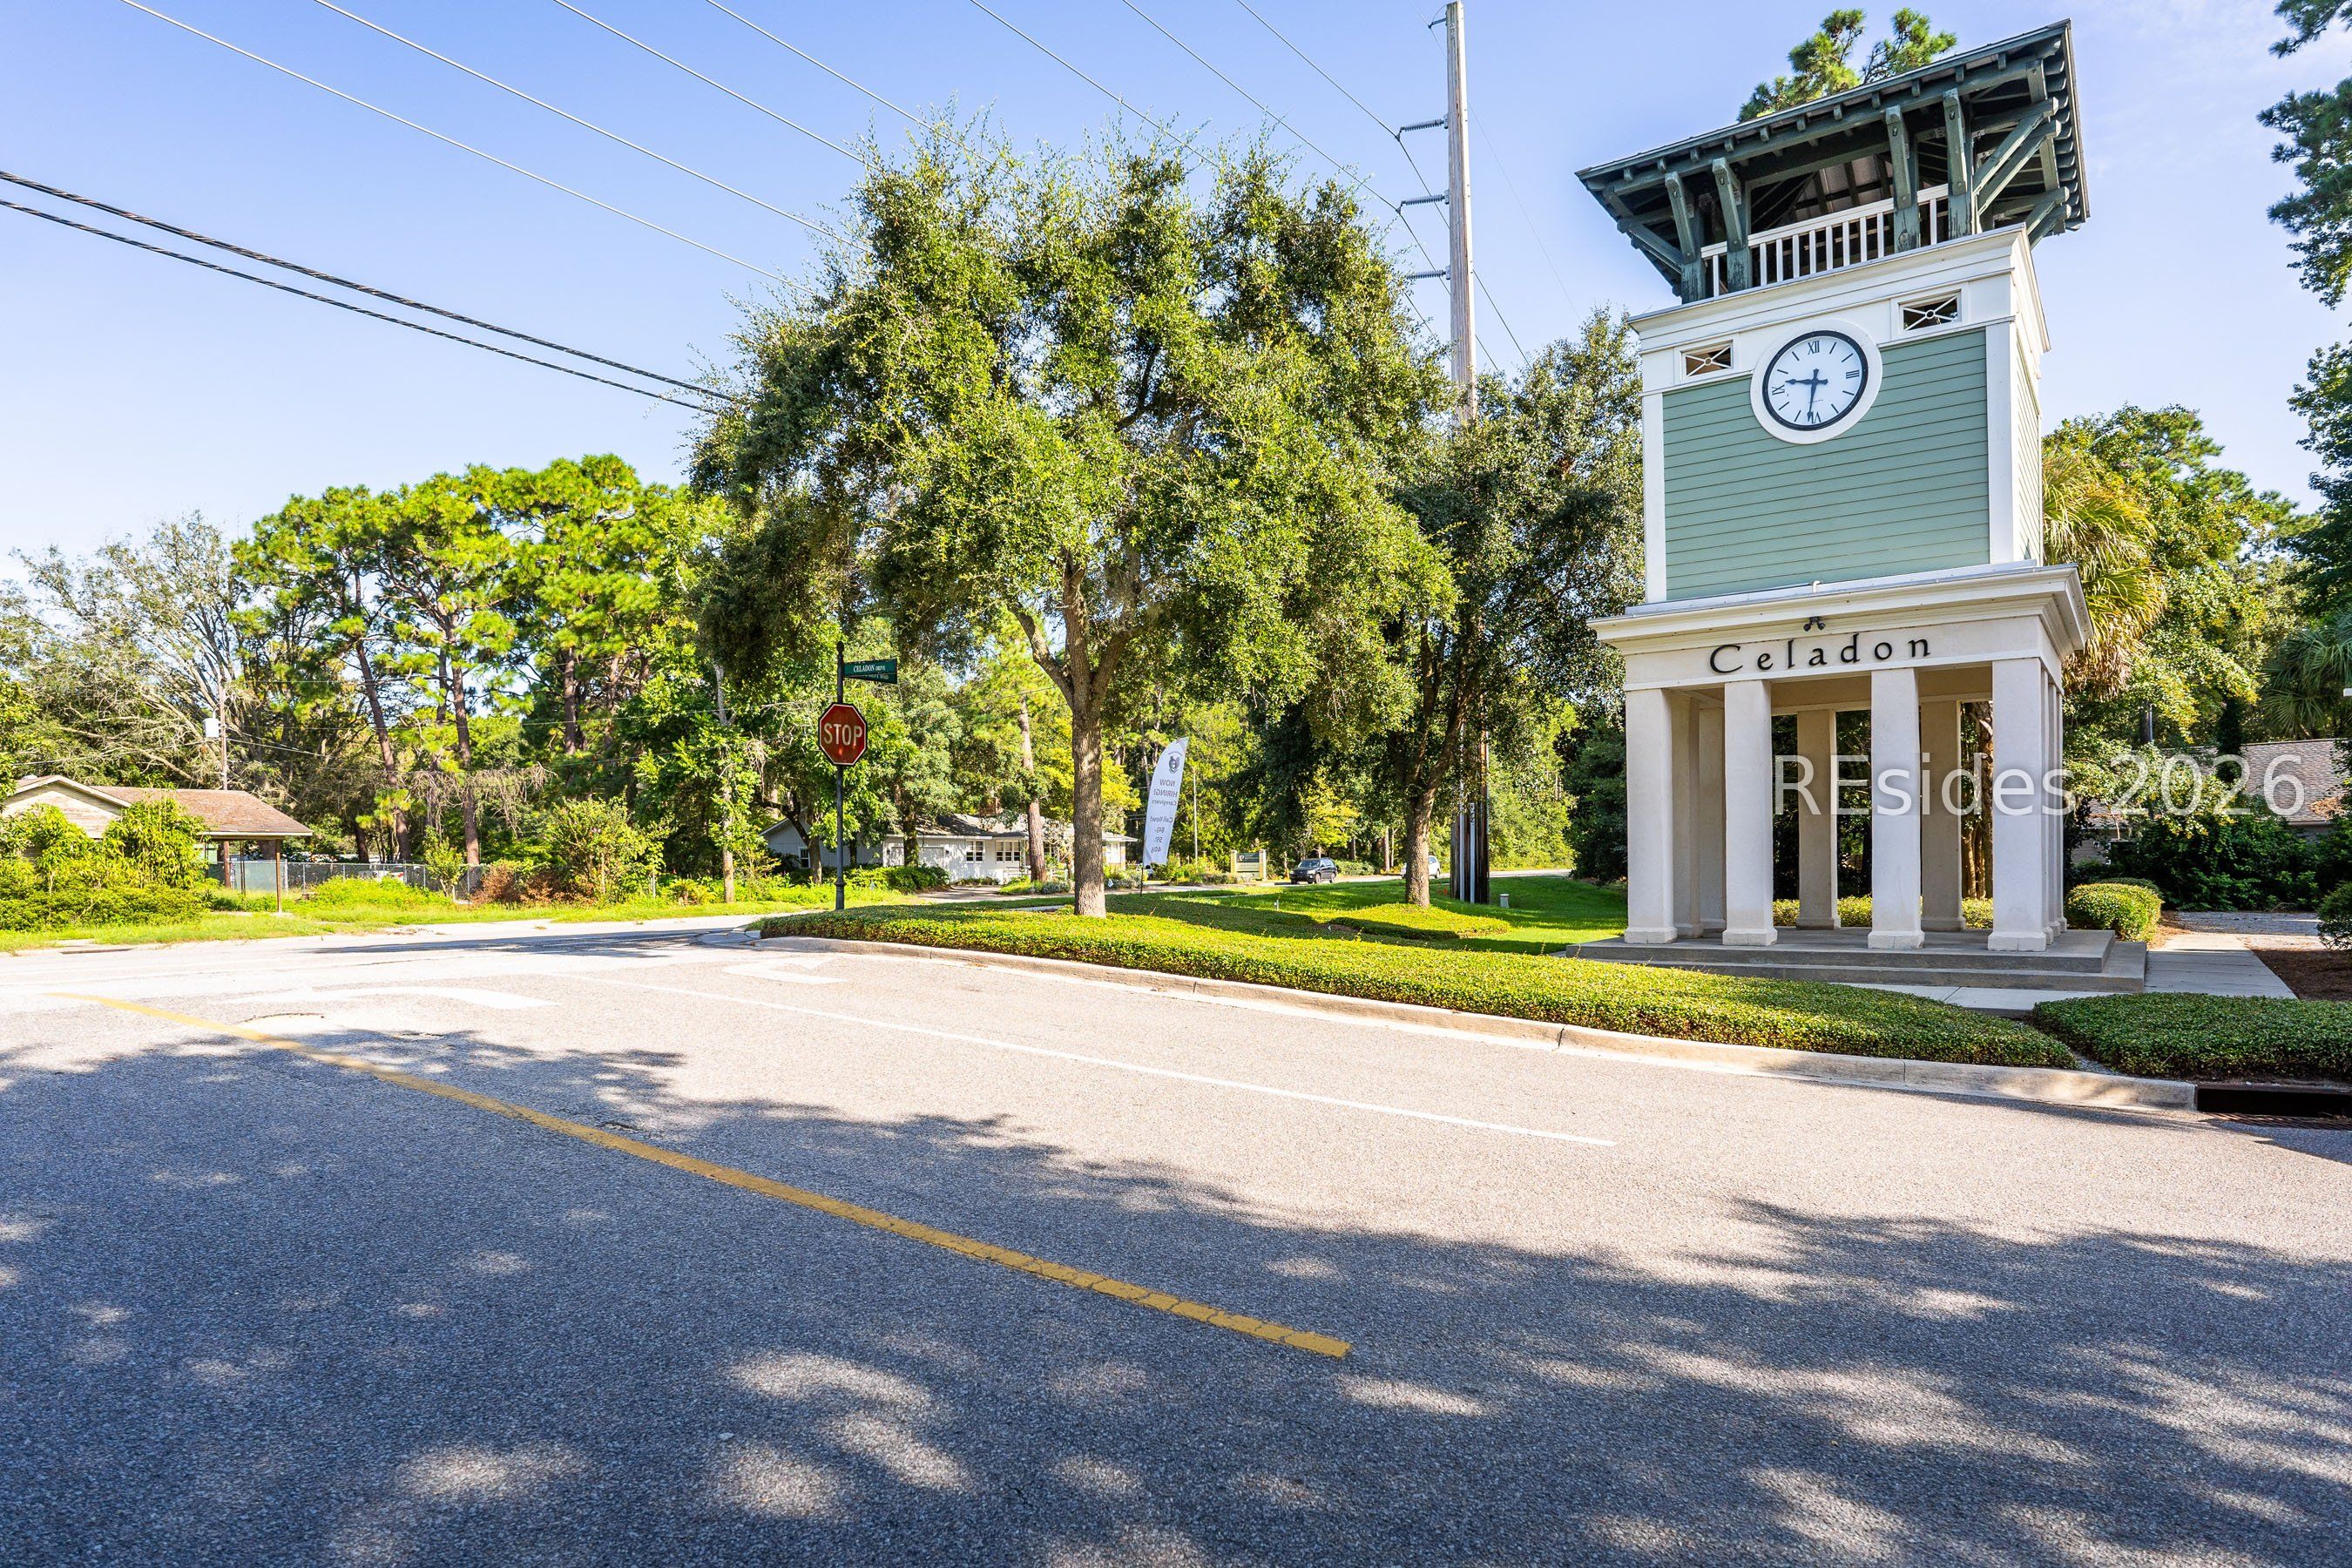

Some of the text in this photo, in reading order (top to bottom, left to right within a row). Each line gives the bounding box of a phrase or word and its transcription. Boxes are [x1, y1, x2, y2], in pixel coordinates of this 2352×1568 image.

[1807, 341, 1820, 355] XII
[1846, 369, 1860, 379] III
[1709, 632, 1930, 674] Celadon
[823, 722, 863, 747] STOP
